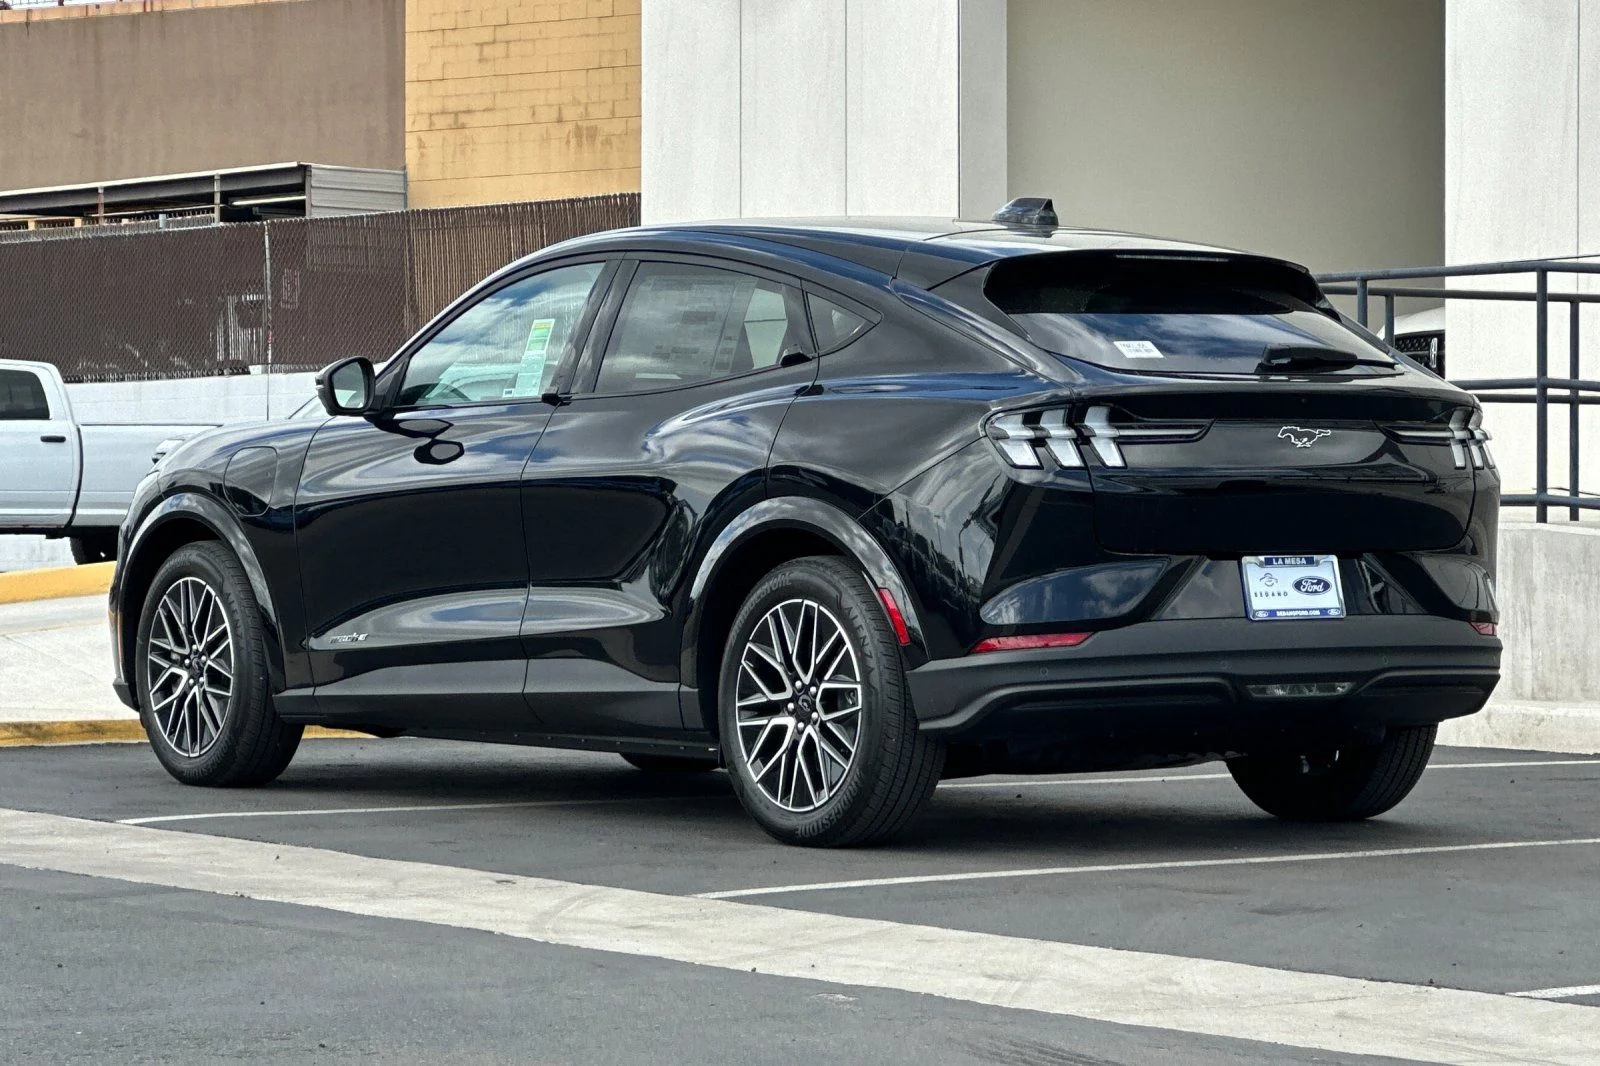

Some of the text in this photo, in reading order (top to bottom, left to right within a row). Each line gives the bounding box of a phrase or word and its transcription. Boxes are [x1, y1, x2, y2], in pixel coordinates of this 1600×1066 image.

[1272, 557, 1307, 565] LA MESA
[1300, 578, 1325, 593] Ford
